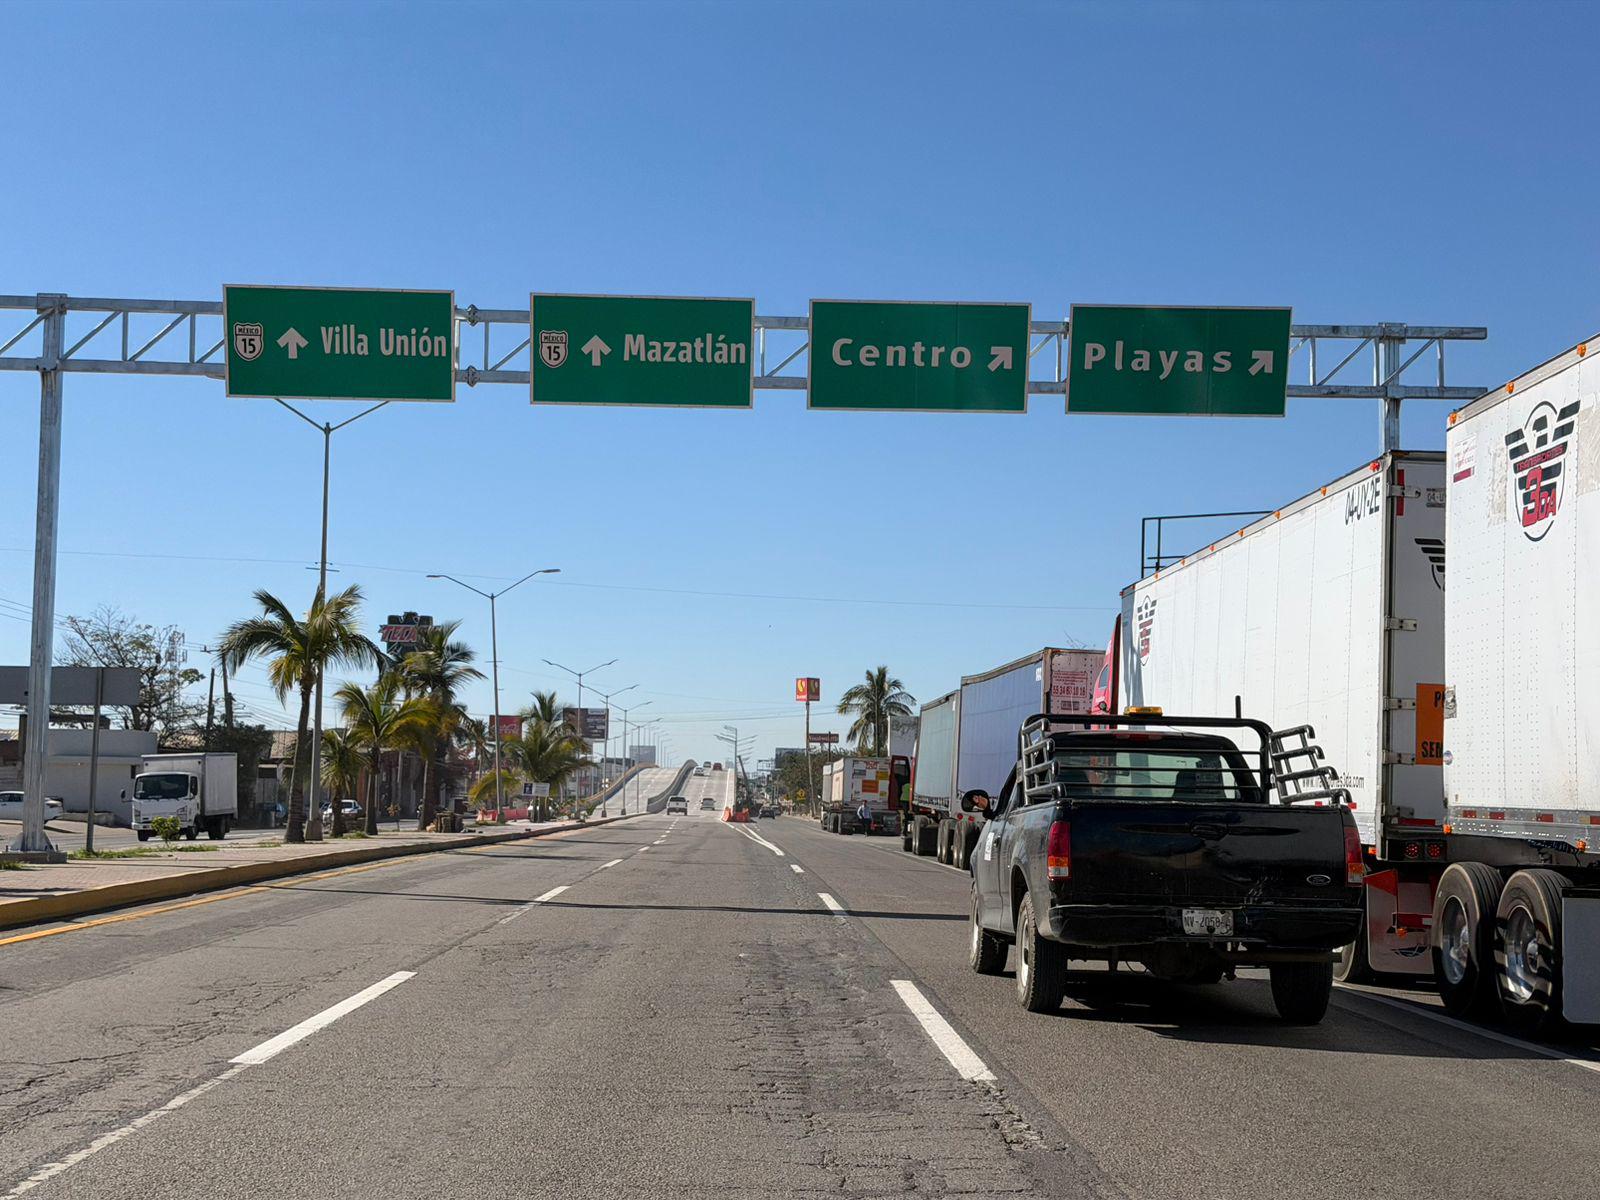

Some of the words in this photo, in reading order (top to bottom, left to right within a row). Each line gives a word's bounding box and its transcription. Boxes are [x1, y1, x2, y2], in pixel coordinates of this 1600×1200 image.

[241, 338, 256, 354] 15
[320, 324, 369, 355] Villa
[379, 327, 447, 357] Unión
[546, 345, 561, 361] 15
[623, 332, 746, 364] Mazatlán
[831, 337, 972, 369] Centro
[1083, 340, 1233, 381] Playas
